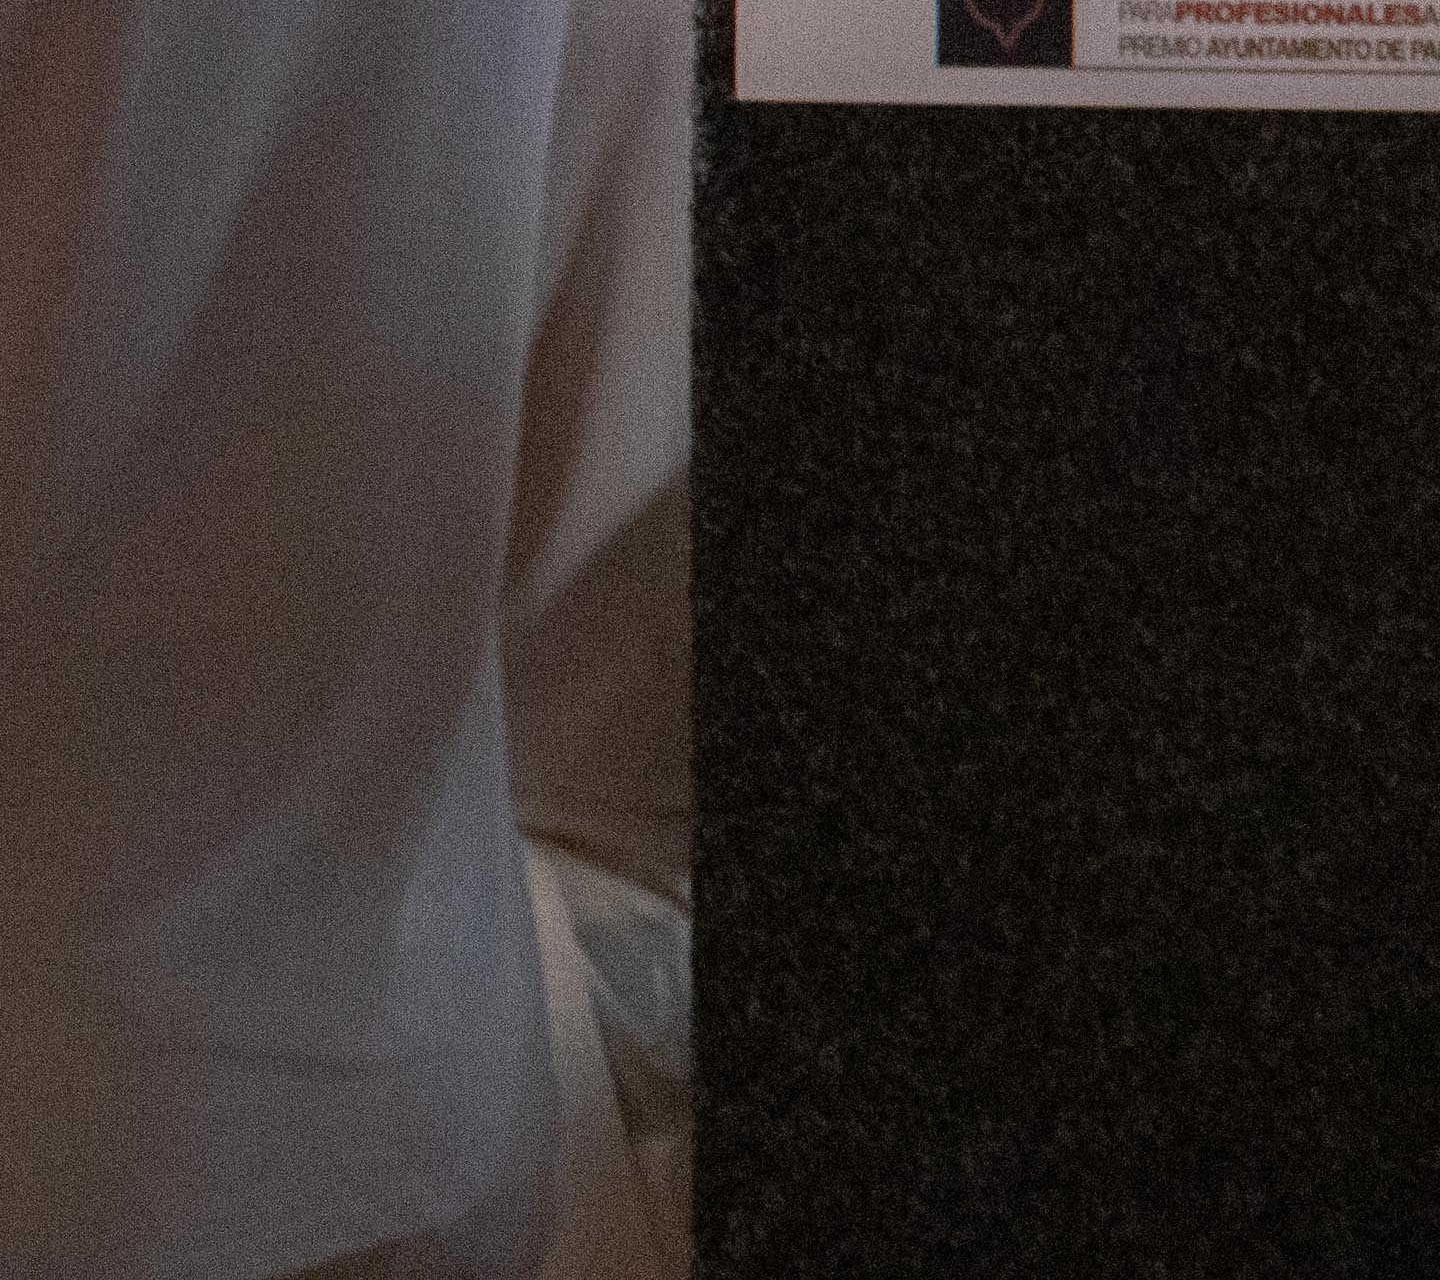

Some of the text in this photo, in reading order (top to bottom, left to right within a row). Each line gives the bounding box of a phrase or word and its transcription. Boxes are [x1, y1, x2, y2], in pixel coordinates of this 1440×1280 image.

[1119, 2, 1174, 23] PARA
[1175, 2, 1421, 25] PROFESIONALES
[1119, 36, 1201, 58] PREMIO
[1206, 37, 1371, 60] AYUNTAMIENTO
[1376, 40, 1406, 61] DE
